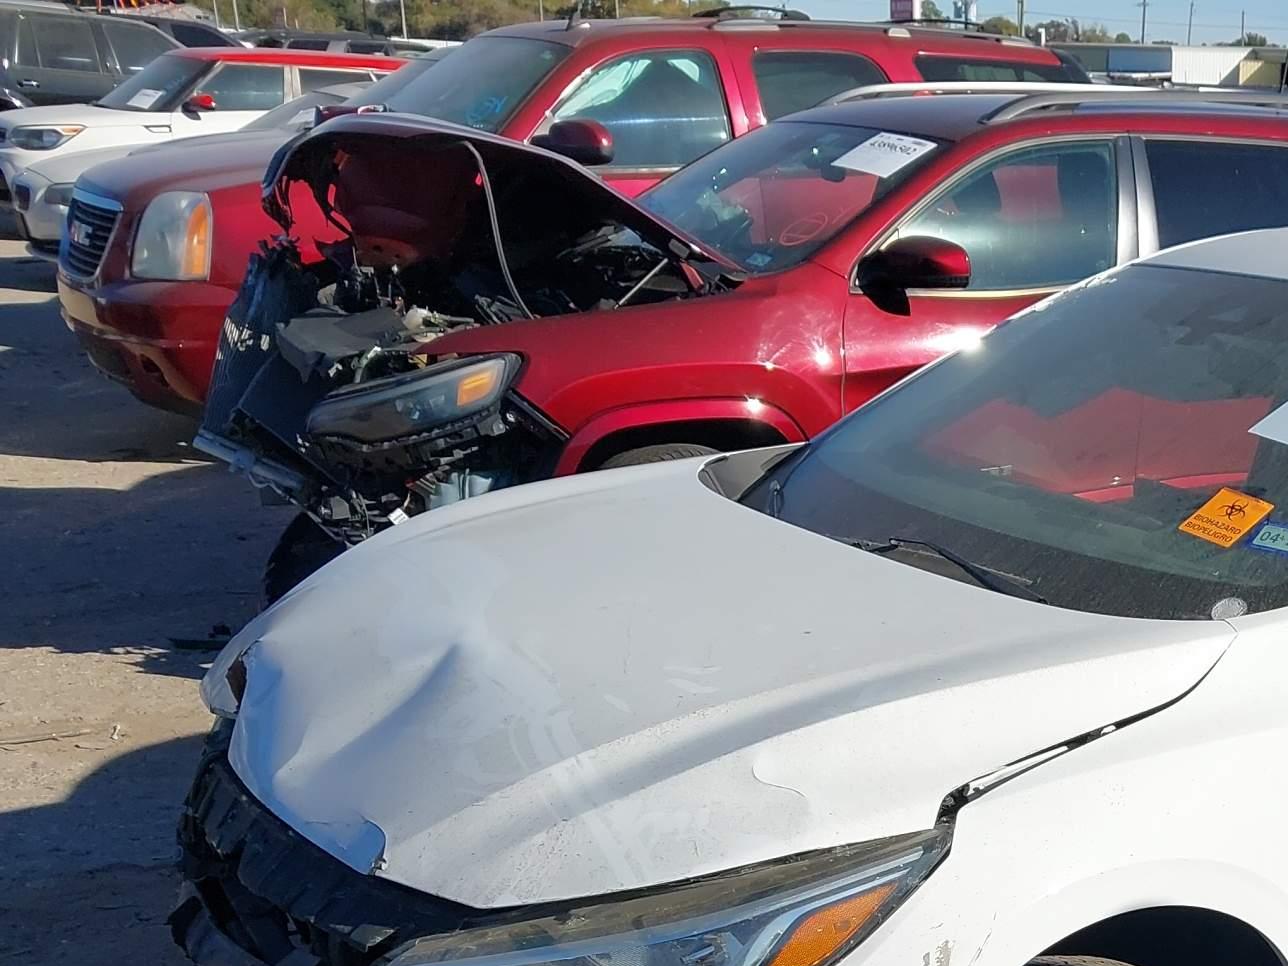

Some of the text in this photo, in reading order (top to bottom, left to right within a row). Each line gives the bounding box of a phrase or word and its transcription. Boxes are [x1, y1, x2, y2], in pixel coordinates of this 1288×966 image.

[1184, 521, 1233, 543] BIOPELIGRO
[1193, 513, 1241, 535] BIOHAZARD
[1260, 531, 1280, 543] 04
